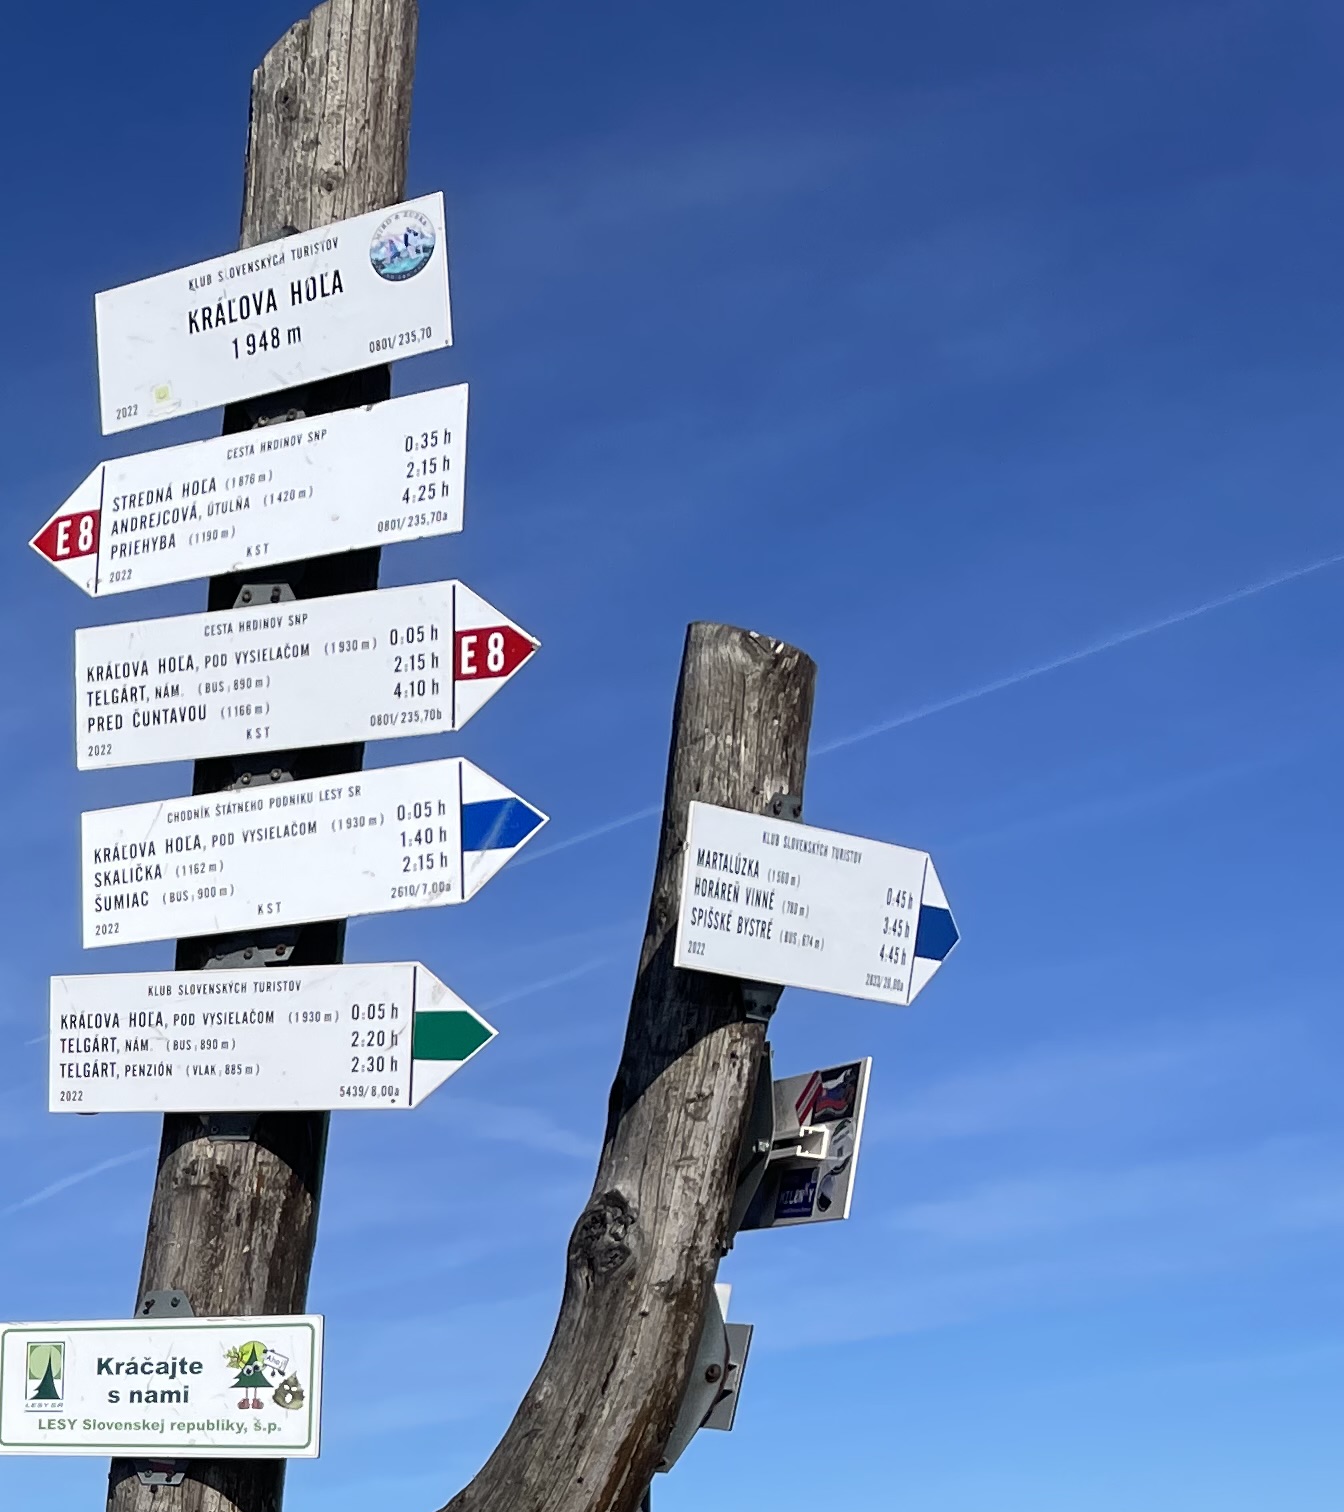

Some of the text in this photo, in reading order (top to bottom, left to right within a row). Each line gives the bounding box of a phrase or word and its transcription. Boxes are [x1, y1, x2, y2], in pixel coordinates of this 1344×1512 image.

[188, 273, 212, 292] KLUB
[290, 236, 339, 261] TURISTOV
[187, 287, 278, 335] KRÁĽOVA
[290, 268, 344, 307] HOĽA
[286, 325, 302, 345] m
[115, 403, 139, 421] 2022
[226, 428, 327, 460] CESTA HRDINOV SNP
[443, 427, 452, 445] h
[442, 454, 450, 472] h
[112, 481, 173, 513] STREDNÁ
[181, 476, 217, 498] HOĽA
[441, 480, 449, 498] h
[111, 500, 202, 536] ANDREJCOVÁ,
[110, 532, 176, 560] PRIEHYBA
[109, 568, 133, 584] 2022
[204, 612, 308, 638] CESTA HRDINOV SNP
[430, 623, 438, 641] h
[86, 658, 149, 683] KRÁĽOVA
[158, 654, 200, 675] HOĽA,
[204, 653, 228, 670] POD
[235, 642, 311, 665] VYSIELAČOM
[431, 651, 439, 669] h
[87, 681, 150, 707] TELGÁRT,
[233, 677, 252, 691] 890
[431, 678, 440, 696] h
[87, 713, 123, 734] PRED
[132, 704, 207, 728] ČUNTAVOU
[88, 743, 112, 757] 2022
[167, 785, 361, 824] CHODNÍK ŠTÁTNEHO PODNIKU LESY SR
[438, 799, 446, 817] h
[93, 840, 156, 865] KRÁĽOVA
[165, 834, 207, 855] HOĽA,
[211, 832, 235, 848] POD
[242, 820, 318, 844] VYSIELAČOM
[439, 826, 447, 843] h
[762, 830, 863, 865] KLUB SLOVENSKÝCH TURISTOV
[440, 851, 448, 868] h
[696, 847, 760, 879] MARTALÚZKA
[94, 863, 162, 888] SKALIČKA
[94, 890, 150, 913] ŠUMIAC
[197, 886, 217, 900] 900
[694, 876, 740, 904] HORÁREŇ
[745, 888, 776, 911] VINNÉ
[907, 891, 913, 910] h
[95, 922, 120, 936] 2022
[690, 906, 733, 932] SPIŠSKÉ
[736, 915, 774, 940] BYSTRÉ
[904, 920, 910, 938] h
[687, 940, 706, 956] 2022
[900, 947, 907, 966] h
[147, 980, 302, 997] KLUB SLOVENSKÝCH TURISTOV
[60, 1010, 120, 1030] KRÁĽOVA
[128, 1010, 169, 1030] HOĽA,
[173, 1013, 195, 1027] POD
[202, 1008, 275, 1026] VYSIELAČOM
[390, 1002, 399, 1020] h
[60, 1034, 120, 1054] TELGÁRT,
[200, 1038, 218, 1051] 890
[390, 1029, 398, 1047] h
[59, 1059, 120, 1080] TELGÁRT,
[124, 1060, 173, 1078] PENZIÓN
[224, 1063, 243, 1076] 885
[390, 1055, 398, 1073] h
[60, 1090, 84, 1102] 2022
[96, 1356, 204, 1381] Kráčajte
[107, 1385, 189, 1404] s nami
[38, 1417, 282, 1435] LESY Slovenskej republiky, š.p.
